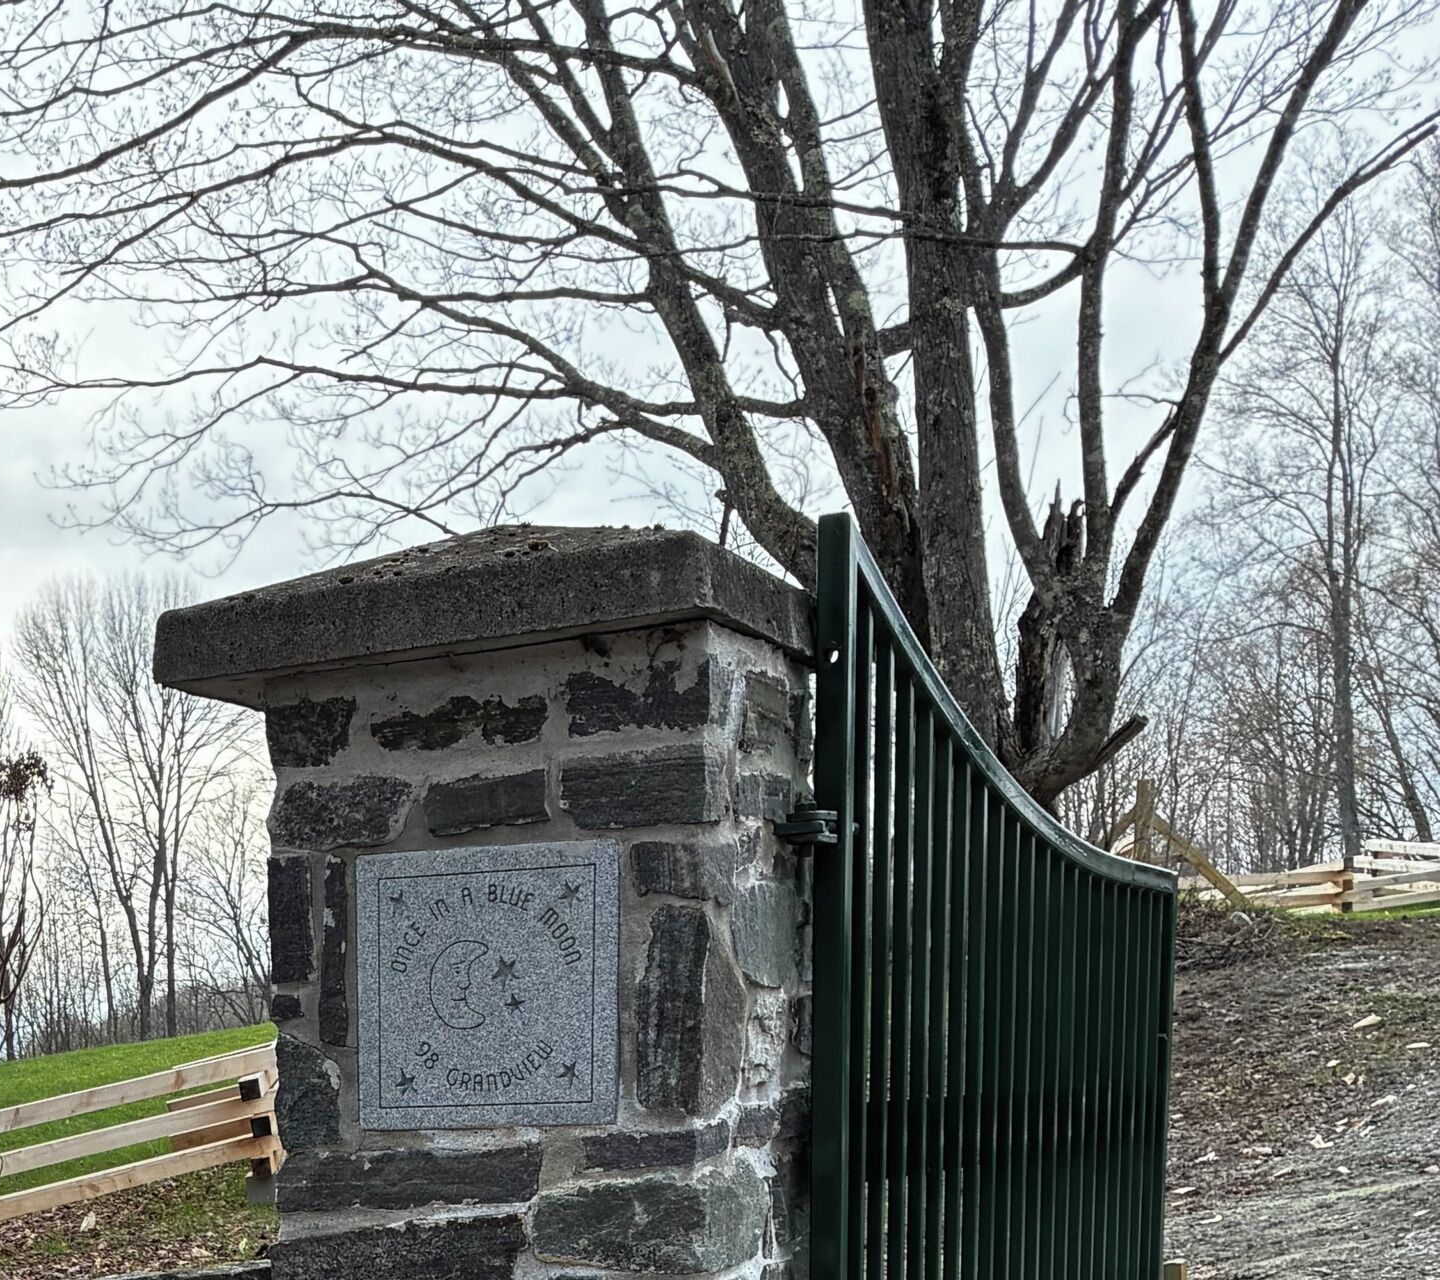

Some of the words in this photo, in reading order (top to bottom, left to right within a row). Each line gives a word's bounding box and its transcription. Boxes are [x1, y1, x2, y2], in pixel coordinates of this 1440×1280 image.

[390, 921, 427, 974] ONCE
[426, 899, 450, 921] IN
[461, 887, 473, 907] A
[487, 884, 536, 912] BLUE
[537, 907, 582, 966] MOON
[415, 1042, 439, 1070] 98
[446, 1039, 554, 1092] GRANDVIEW
